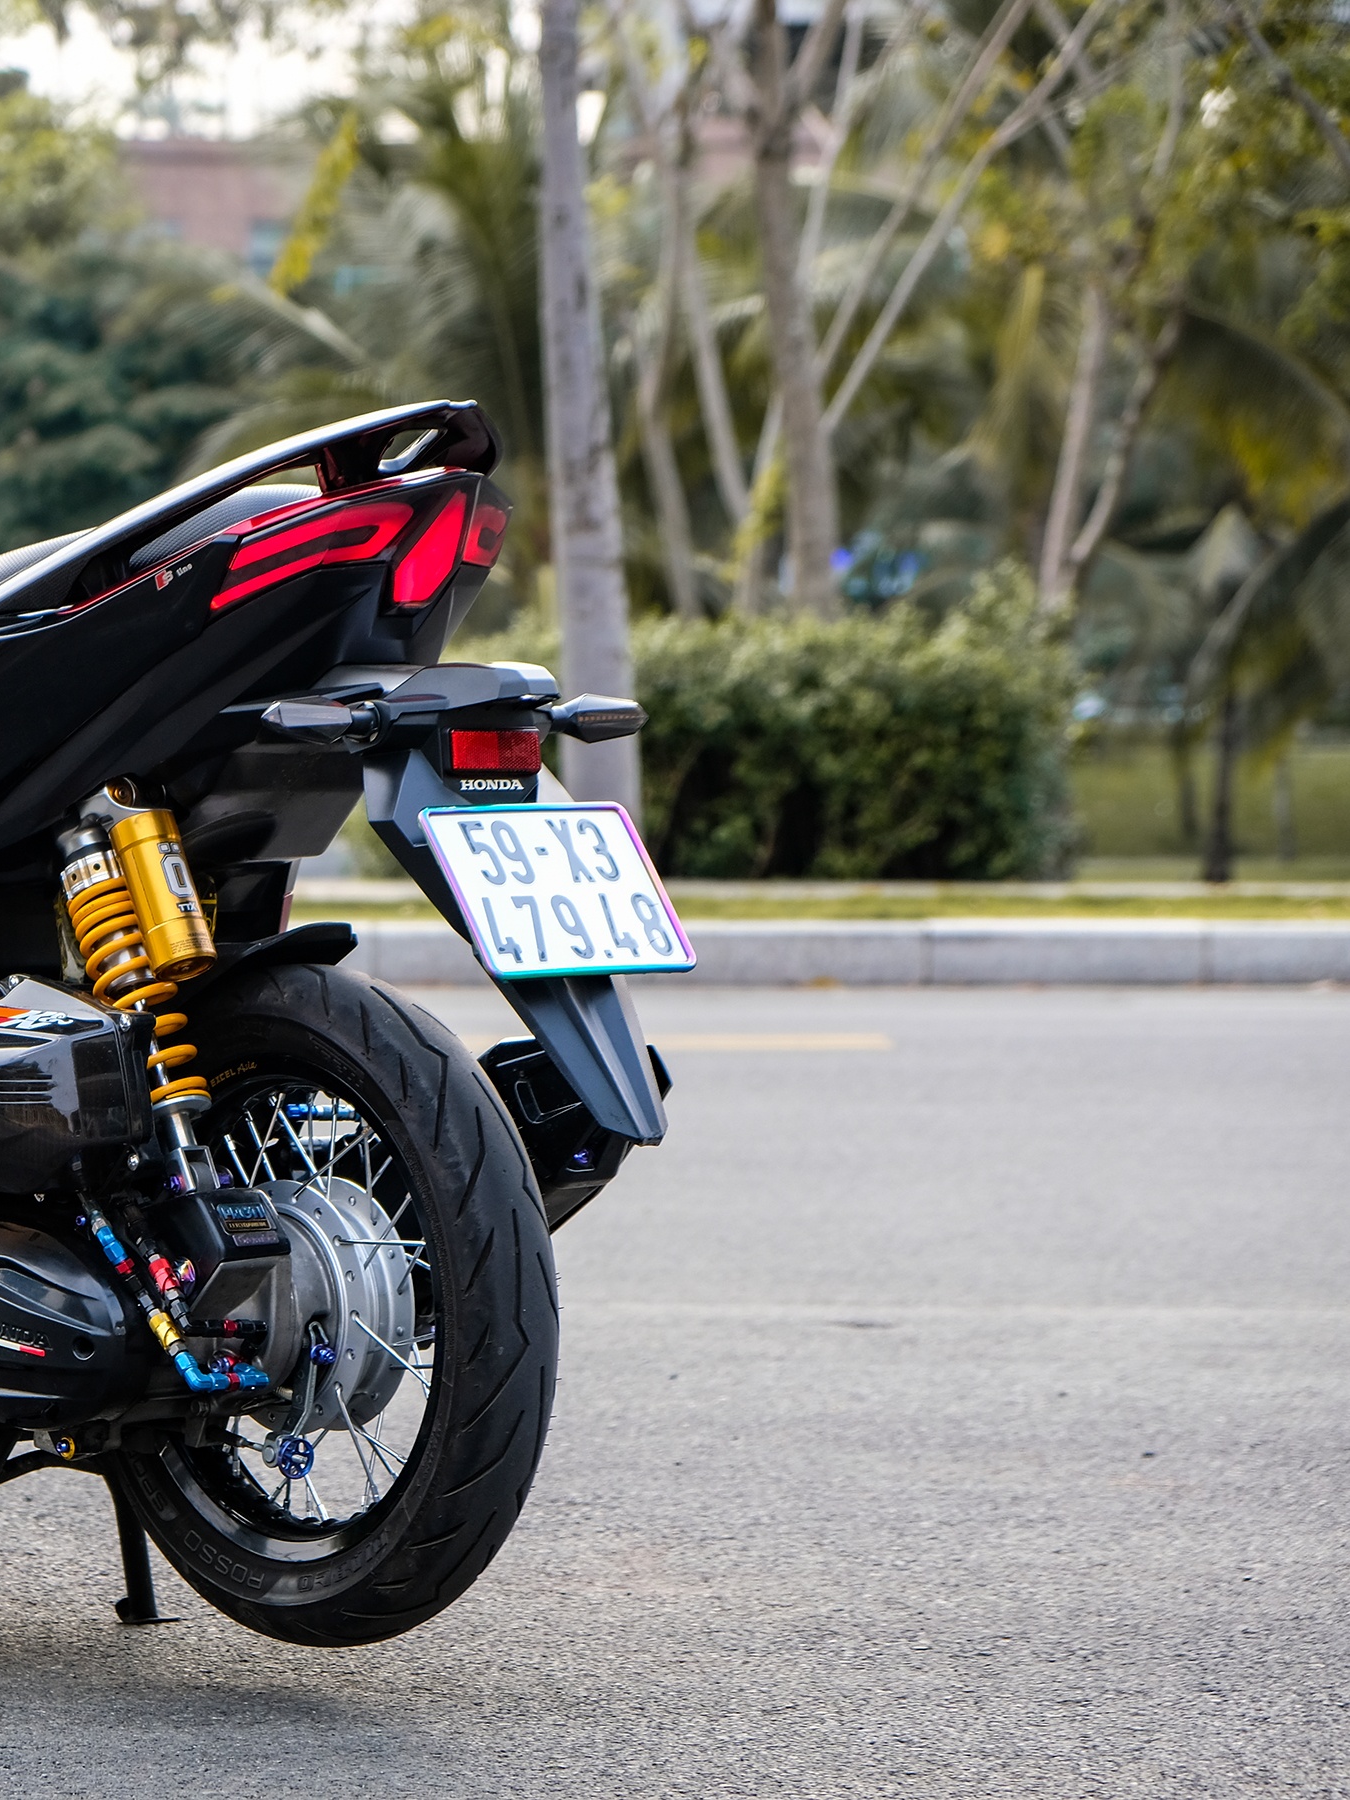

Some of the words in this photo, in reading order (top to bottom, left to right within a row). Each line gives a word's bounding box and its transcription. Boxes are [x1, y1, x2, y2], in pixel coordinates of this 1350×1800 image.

[460, 779, 525, 791] HONDA
[458, 818, 620, 885] 59-X3
[177, 902, 199, 912] TTX
[482, 892, 674, 963] 479.48
[210, 1069, 236, 1087] EXCEL
[183, 1529, 265, 1590] ROSSO
